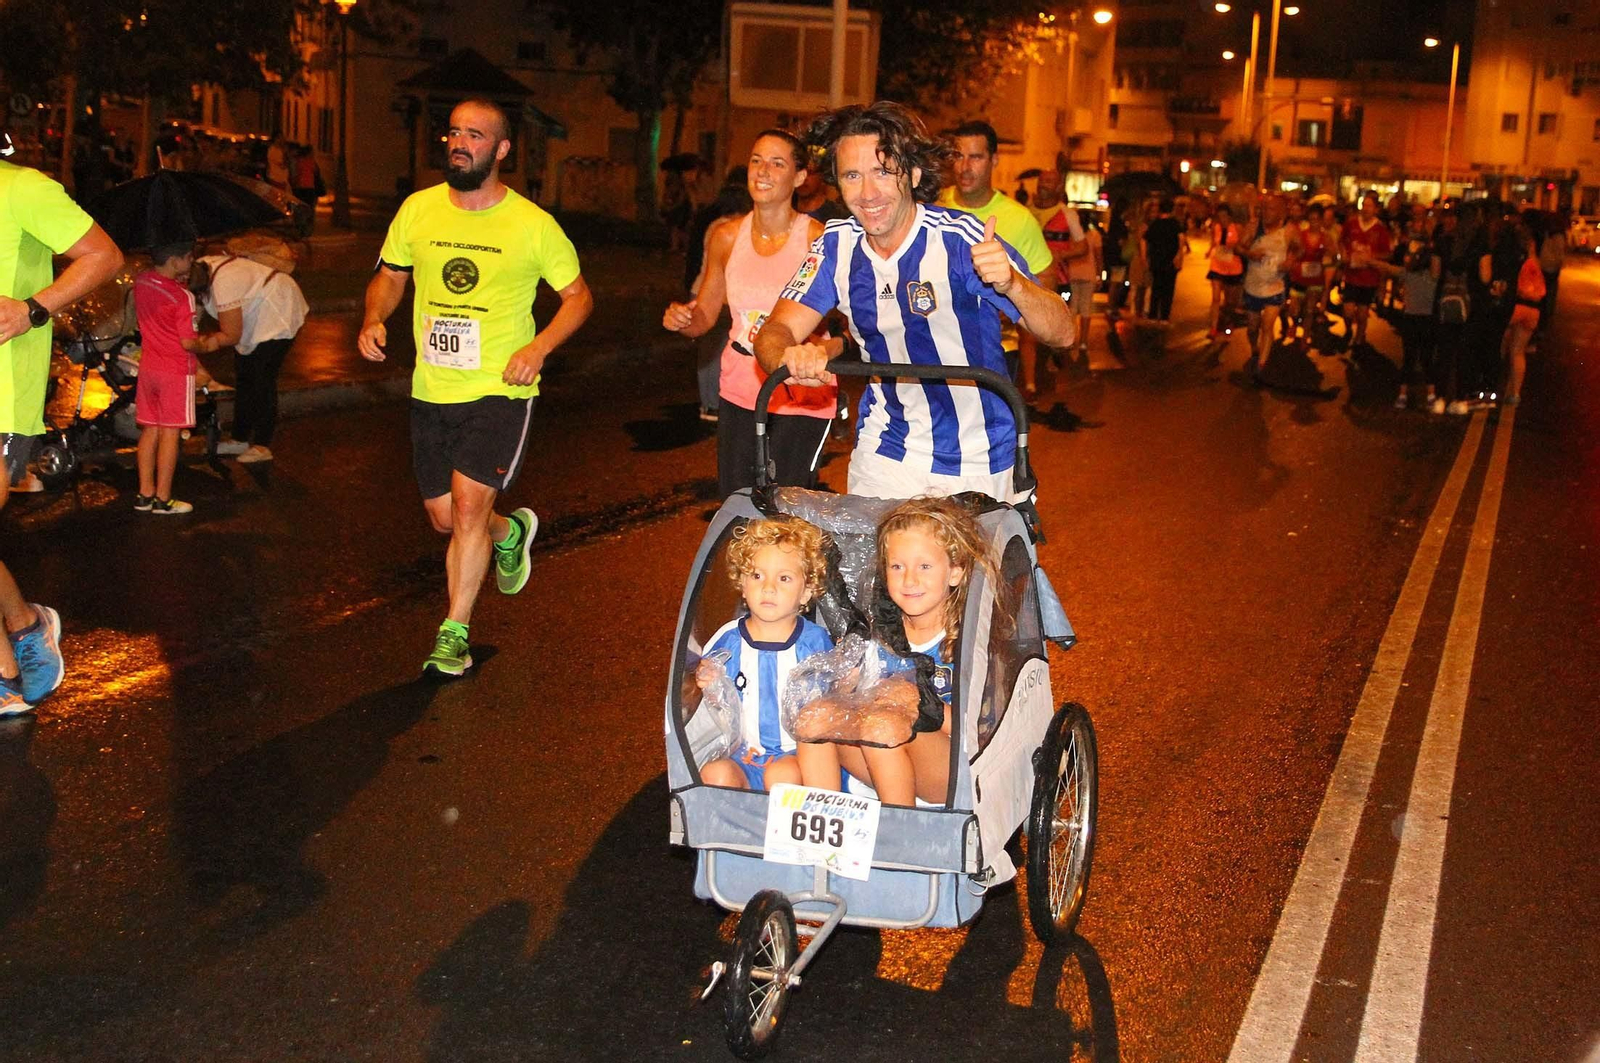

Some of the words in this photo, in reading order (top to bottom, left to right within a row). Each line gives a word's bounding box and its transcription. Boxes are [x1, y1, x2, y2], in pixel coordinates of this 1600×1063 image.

[453, 242, 502, 254] CICLODEPORTIVA
[791, 280, 806, 288] LFP
[434, 319, 471, 328] NOCTURNA
[429, 332, 460, 353] 490
[806, 791, 869, 811] NOCTURNA
[801, 802, 817, 813] DE
[791, 811, 844, 848] 693
